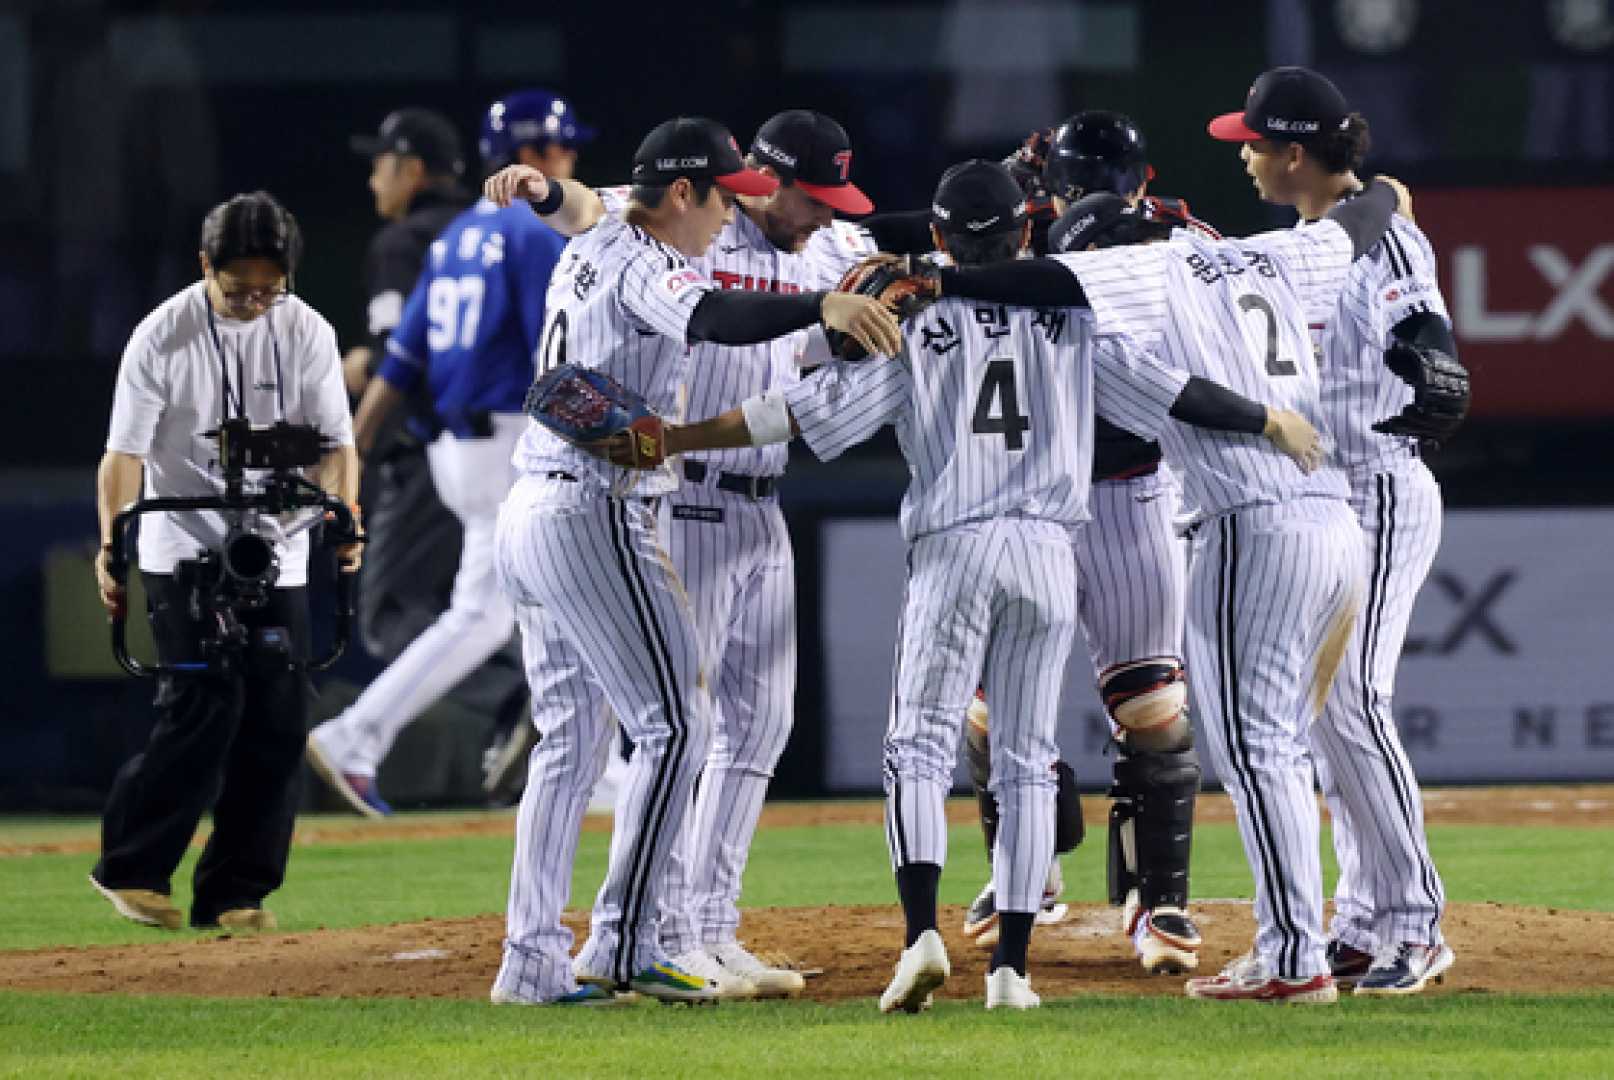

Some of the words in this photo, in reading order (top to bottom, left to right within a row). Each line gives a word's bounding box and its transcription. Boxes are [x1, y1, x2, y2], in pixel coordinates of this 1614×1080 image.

[427, 274, 484, 350] 97
[1238, 294, 1297, 376] 2
[1453, 244, 1614, 340] LX
[972, 359, 1029, 451] 4
